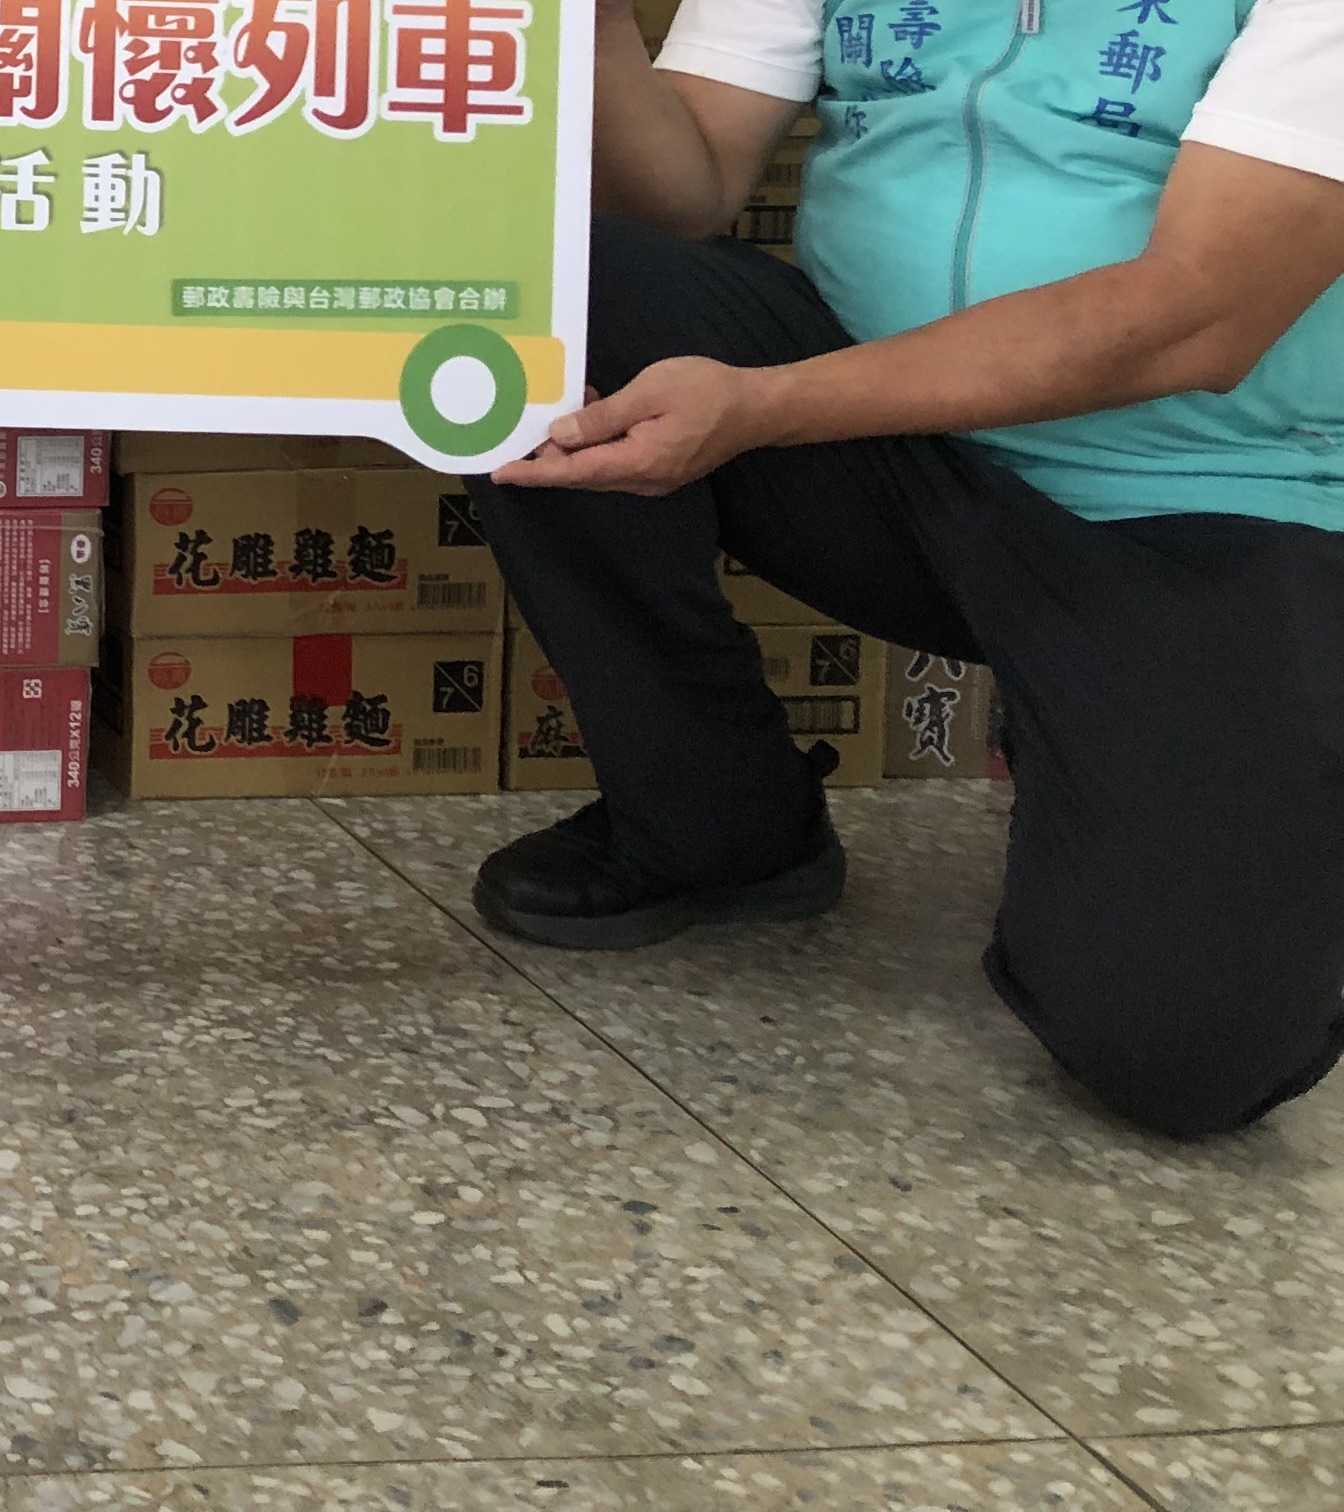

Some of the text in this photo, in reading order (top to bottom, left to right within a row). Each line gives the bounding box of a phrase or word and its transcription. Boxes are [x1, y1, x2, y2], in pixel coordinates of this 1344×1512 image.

[181, 285, 507, 313] 郵政壽險與台灣郵政協會合辦
[169, 525, 399, 588] 花雕雞麵
[64, 573, 94, 636] 黑八寶
[164, 691, 392, 753] 花雕雞麵
